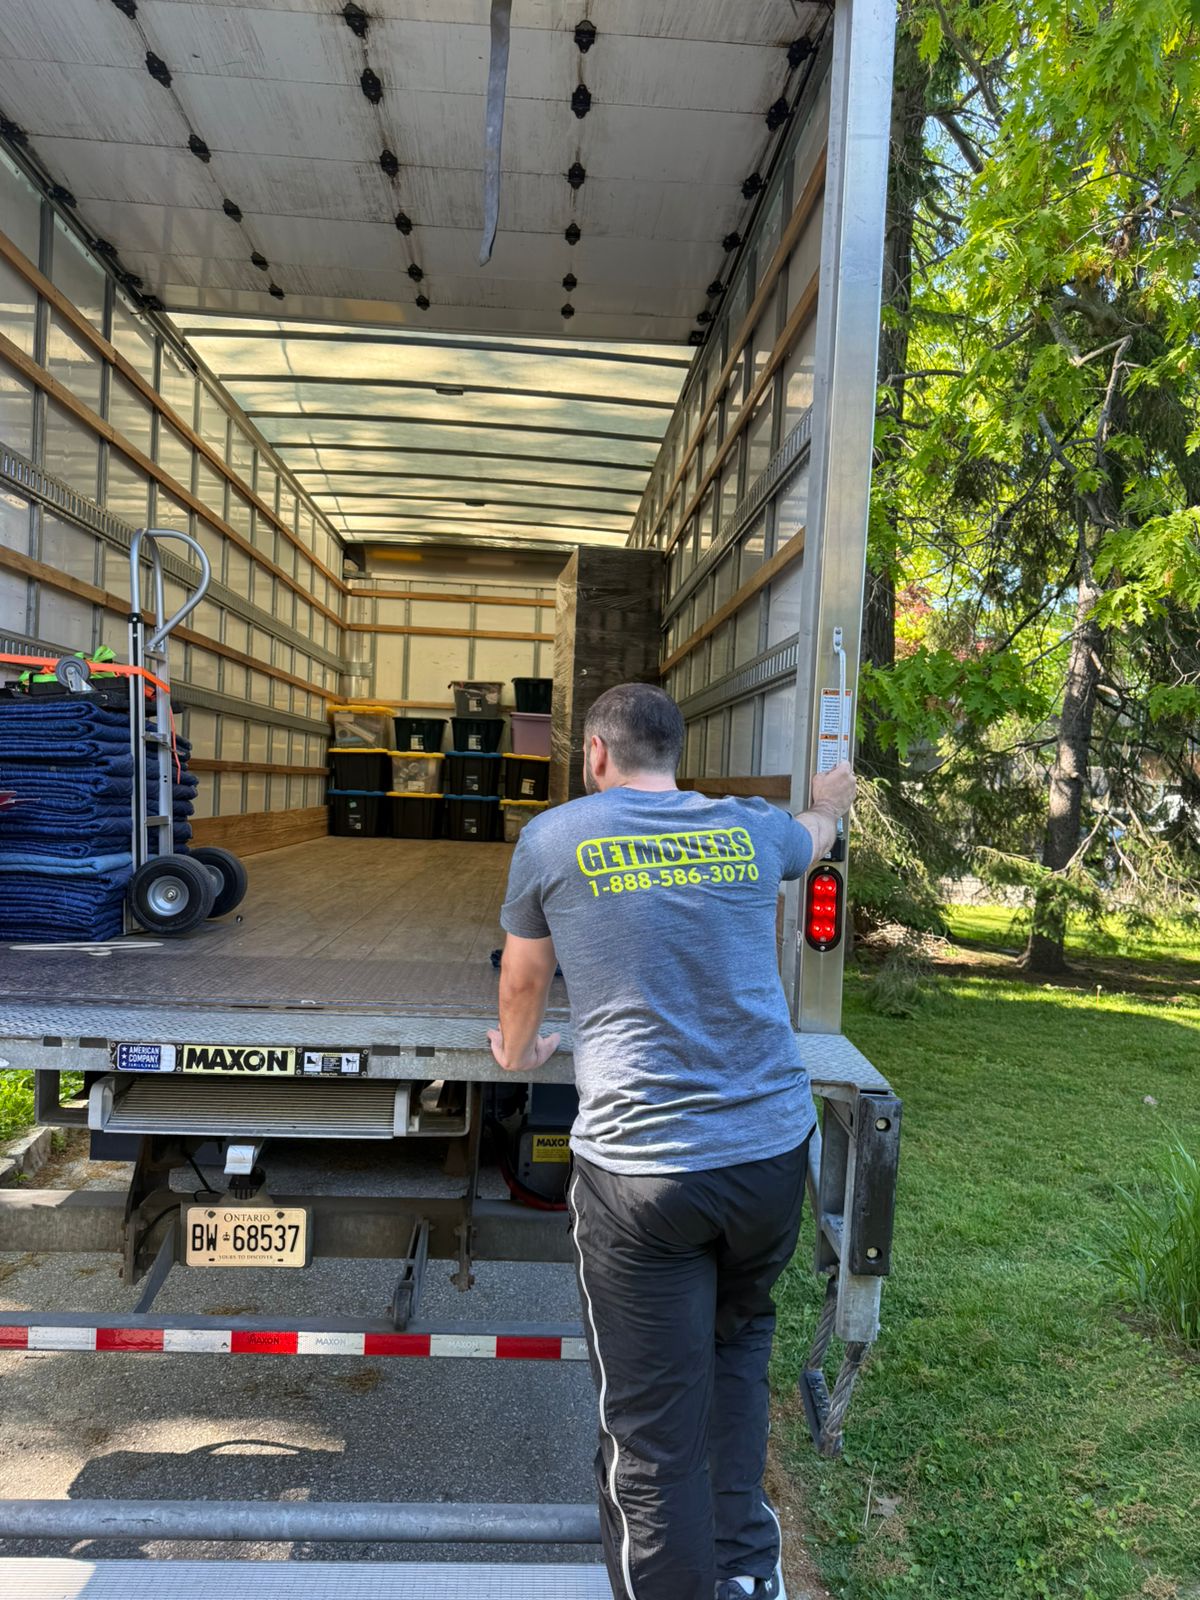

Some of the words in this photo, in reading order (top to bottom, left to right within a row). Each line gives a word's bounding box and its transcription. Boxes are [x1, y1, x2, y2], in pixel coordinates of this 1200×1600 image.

[579, 828, 753, 874] GETMOVERS
[588, 863, 760, 897] 1-888-586-3070
[128, 1046, 160, 1055] AMERICAN
[128, 1054, 159, 1064] COMPANY
[185, 1047, 289, 1072] MAXON
[191, 1223, 218, 1252] BW
[232, 1224, 300, 1253] 68537
[248, 1336, 280, 1345] MAXON
[315, 1338, 347, 1346] MAXON
[447, 1340, 480, 1350] MAXON
